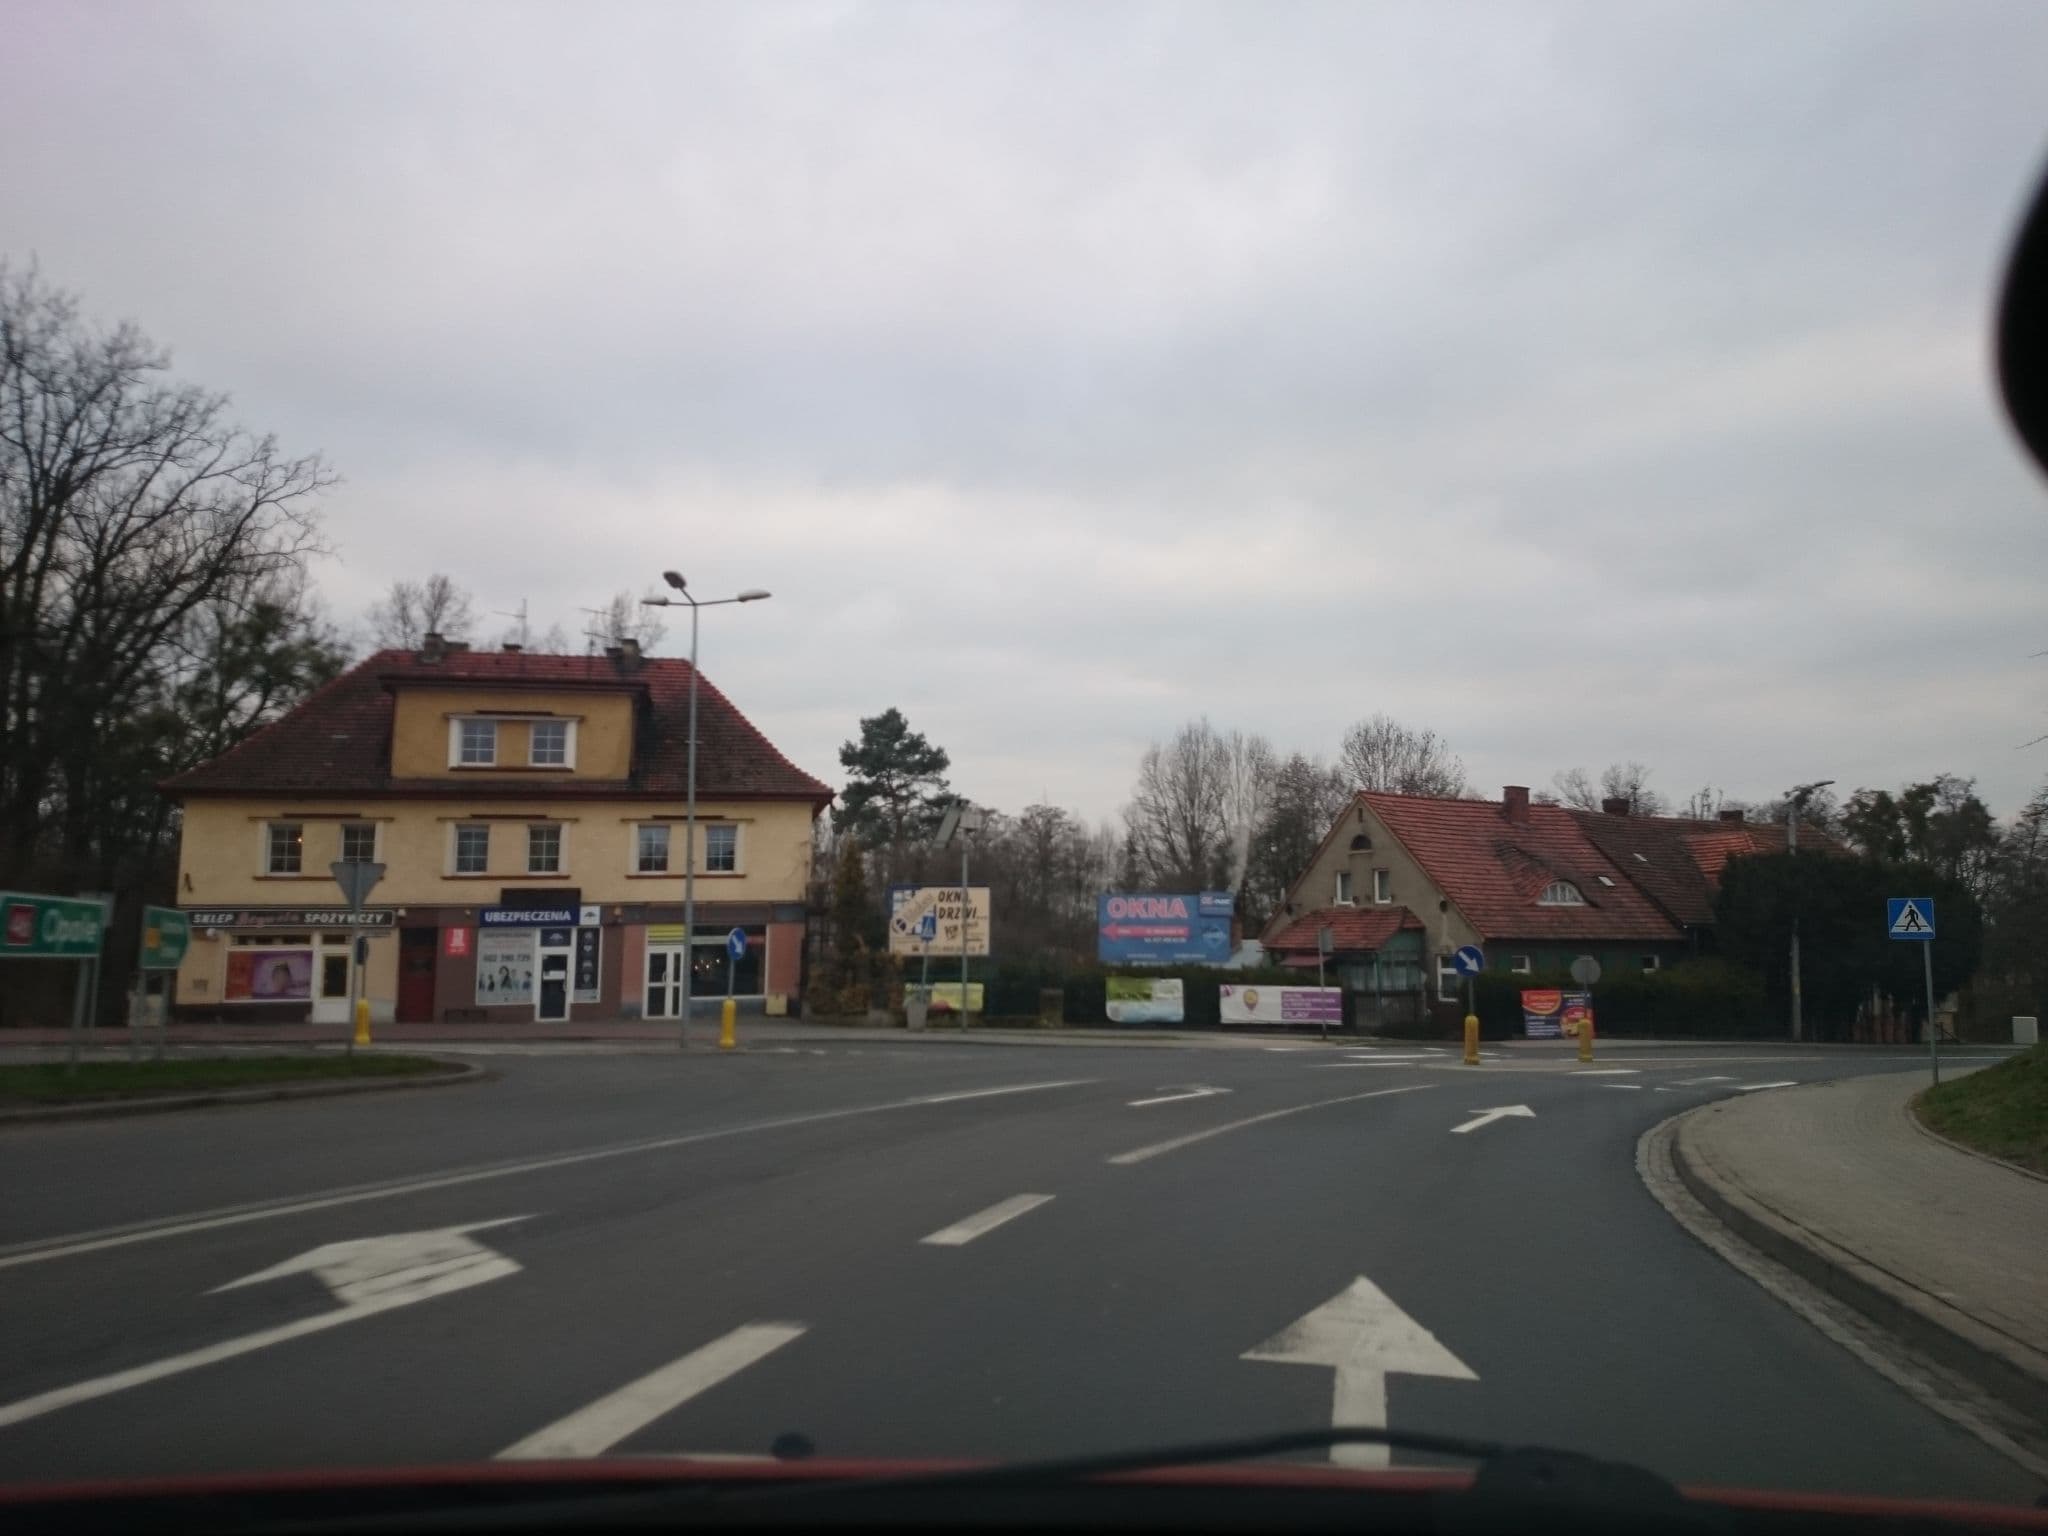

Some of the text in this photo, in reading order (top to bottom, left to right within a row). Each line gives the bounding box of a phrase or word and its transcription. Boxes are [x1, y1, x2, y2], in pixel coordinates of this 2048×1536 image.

[938, 889, 972, 904] OKN,
[1106, 897, 1189, 919] OKNA
[192, 913, 235, 924] SKLEP
[484, 910, 571, 923] UBEZPIECZENIA
